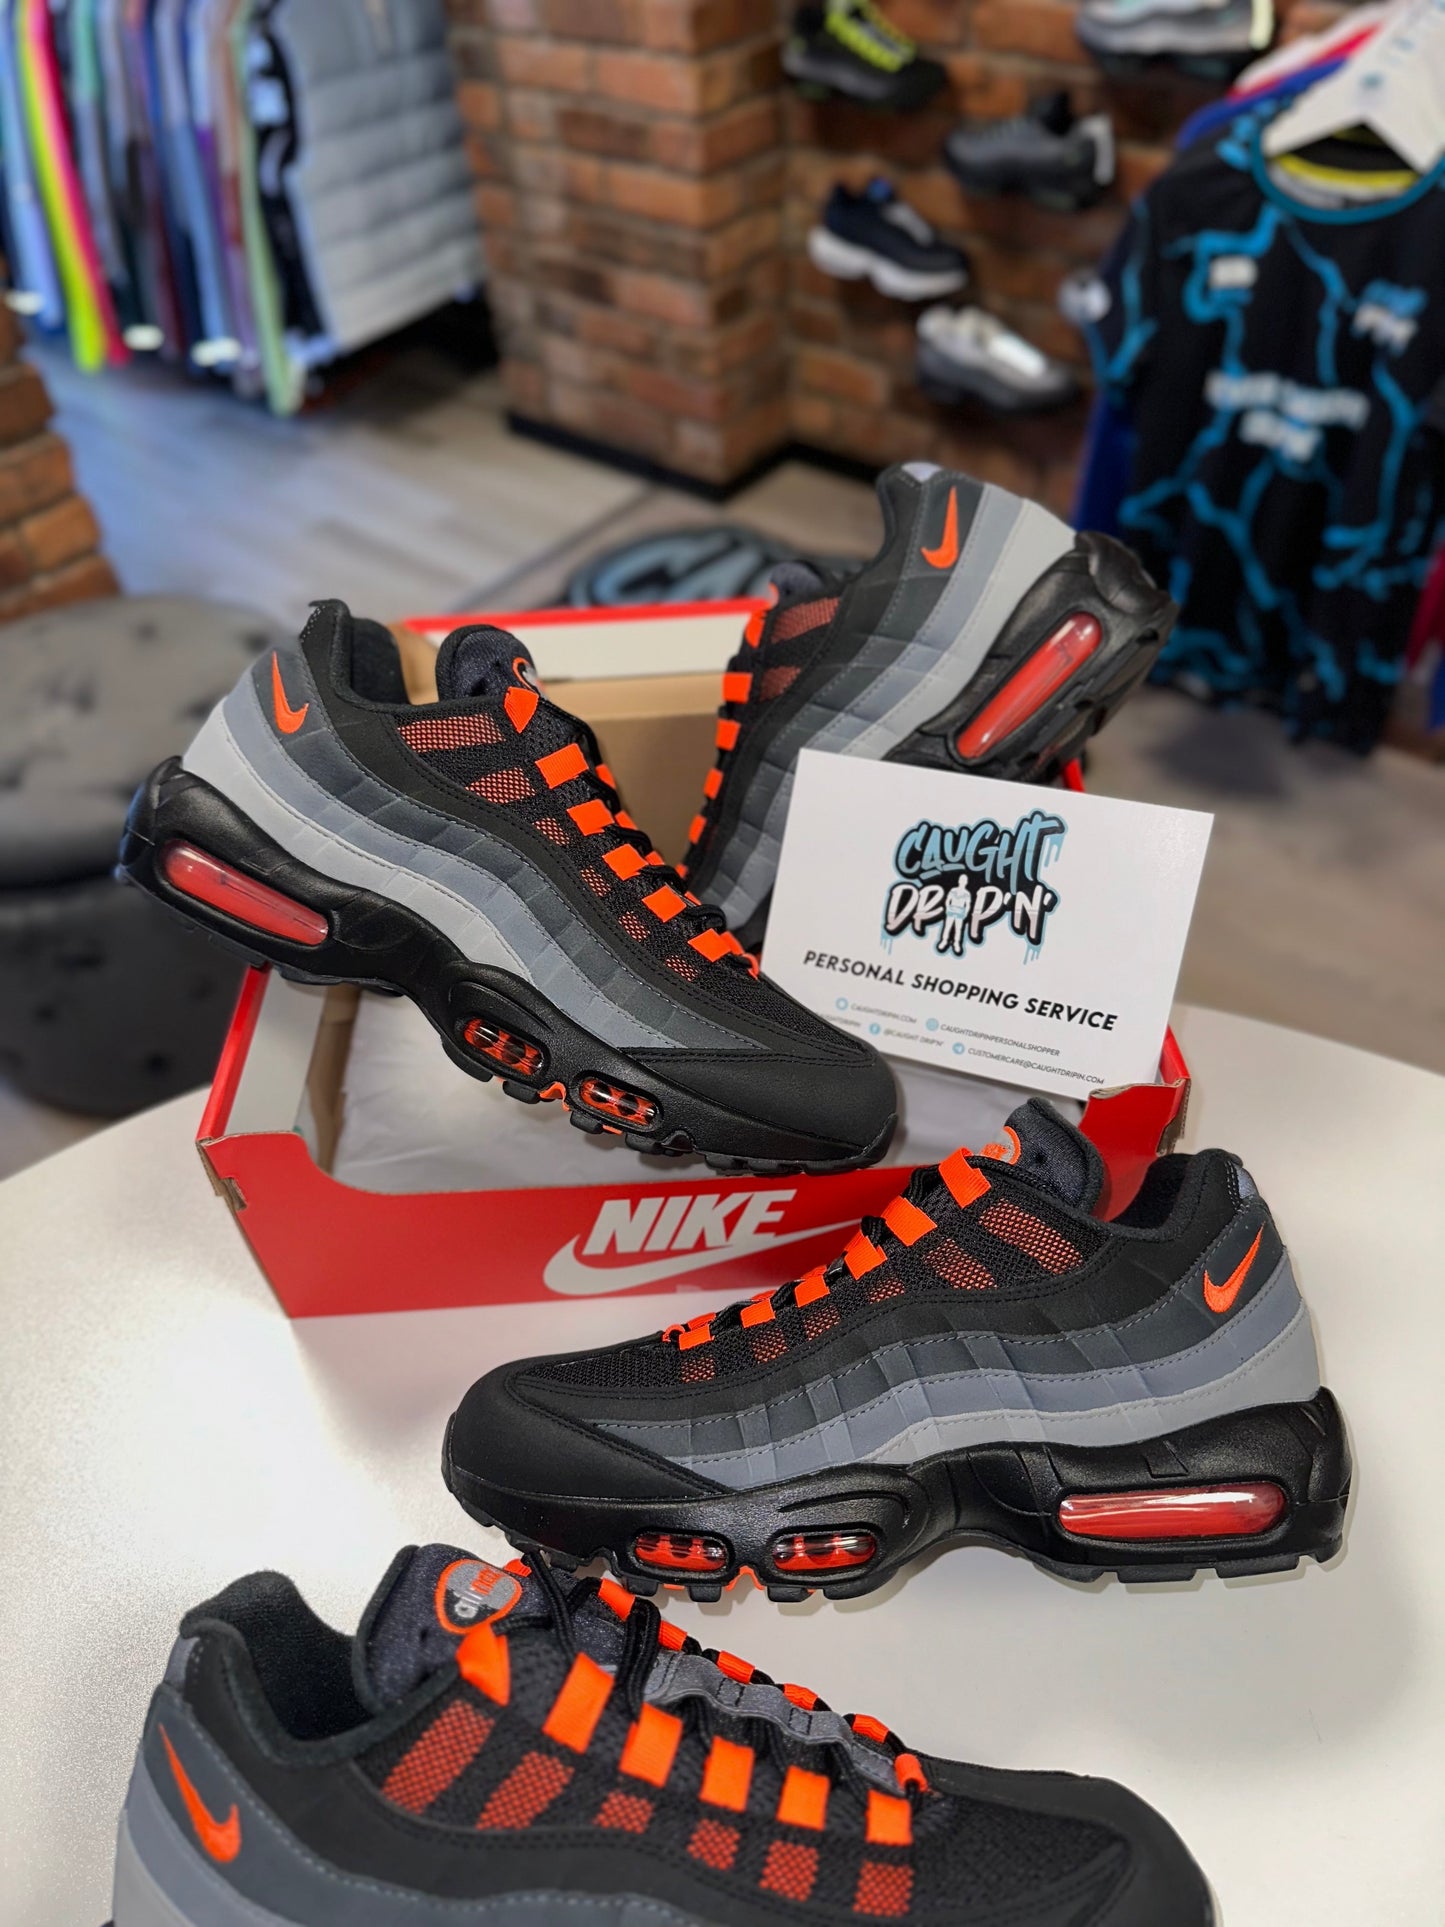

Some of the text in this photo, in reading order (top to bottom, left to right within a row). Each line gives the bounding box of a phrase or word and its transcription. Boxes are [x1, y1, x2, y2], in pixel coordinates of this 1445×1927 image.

[895, 810, 1066, 894] CAUGHT
[803, 950, 1118, 1032] PERSONAL SHOPPING SERVICE
[940, 1023, 1061, 1057] CAUGHTDRIPINPERSONALSHOPPER
[967, 1047, 1105, 1085] CUSTOMERCARE@CAUGHTDRIPIN.COM
[582, 1189, 797, 1256] NIKE
